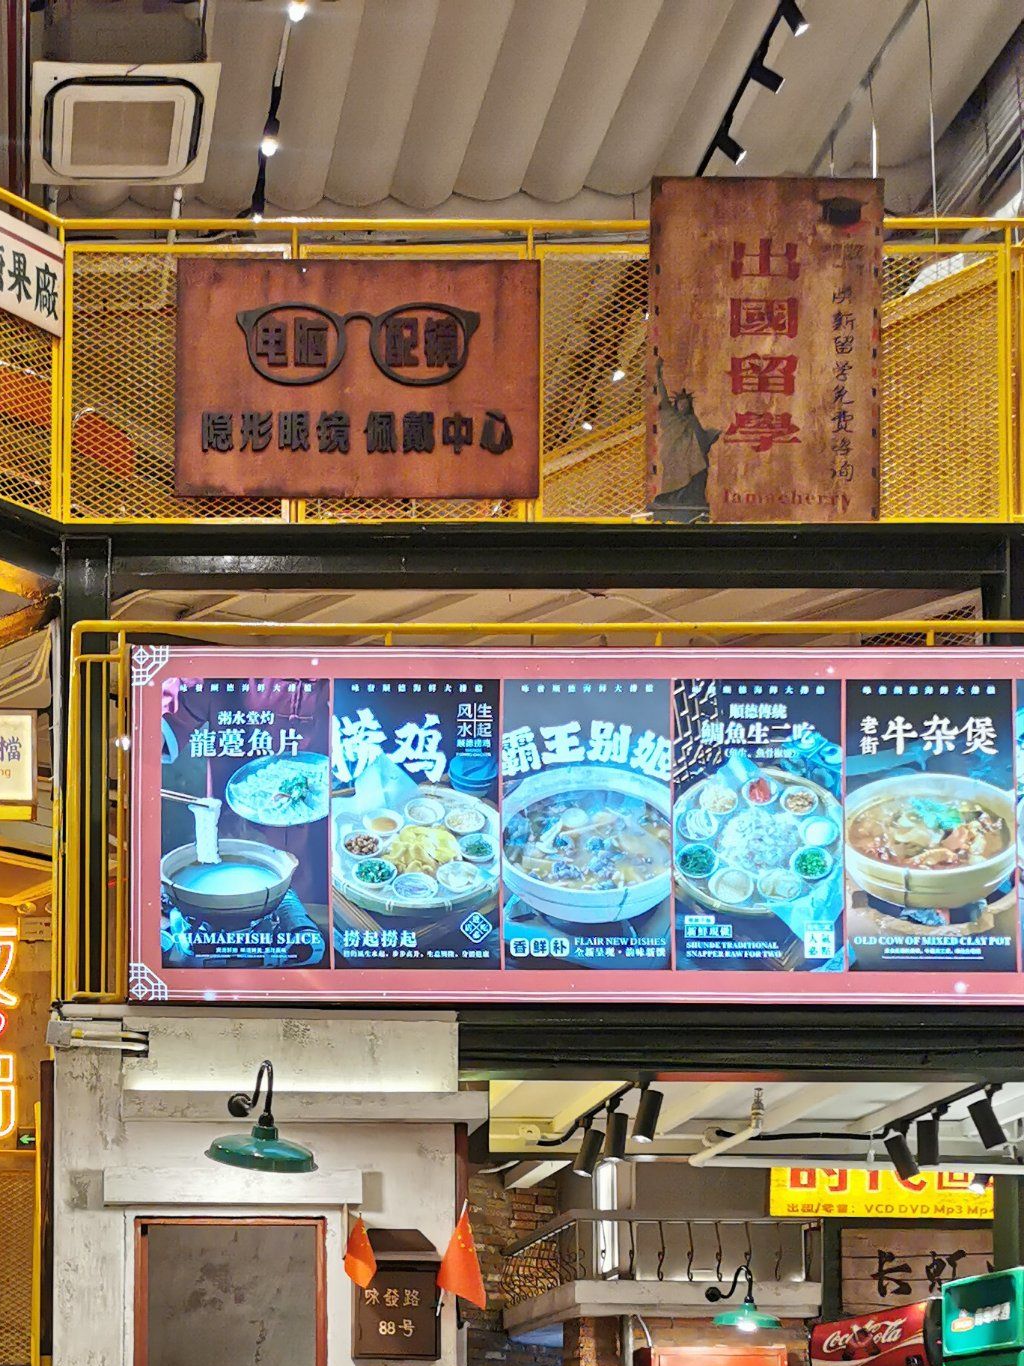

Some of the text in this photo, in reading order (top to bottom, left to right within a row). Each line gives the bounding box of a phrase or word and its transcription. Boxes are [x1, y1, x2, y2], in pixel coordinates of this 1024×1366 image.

[724, 238, 802, 452] 出國留學
[860, 714, 999, 756] 老街 牛杂煲
[277, 932, 320, 945] SLICE
[606, 937, 629, 945] NEW
[630, 937, 666, 945] DISHES
[853, 936, 1011, 946] OLD COW OF MIXED CLAY POT
[721, 941, 779, 949] TRADITIONAL
[865, 1204, 894, 1214] VCD
[898, 1204, 929, 1214] DVD
[933, 1205, 963, 1216] Mp3
